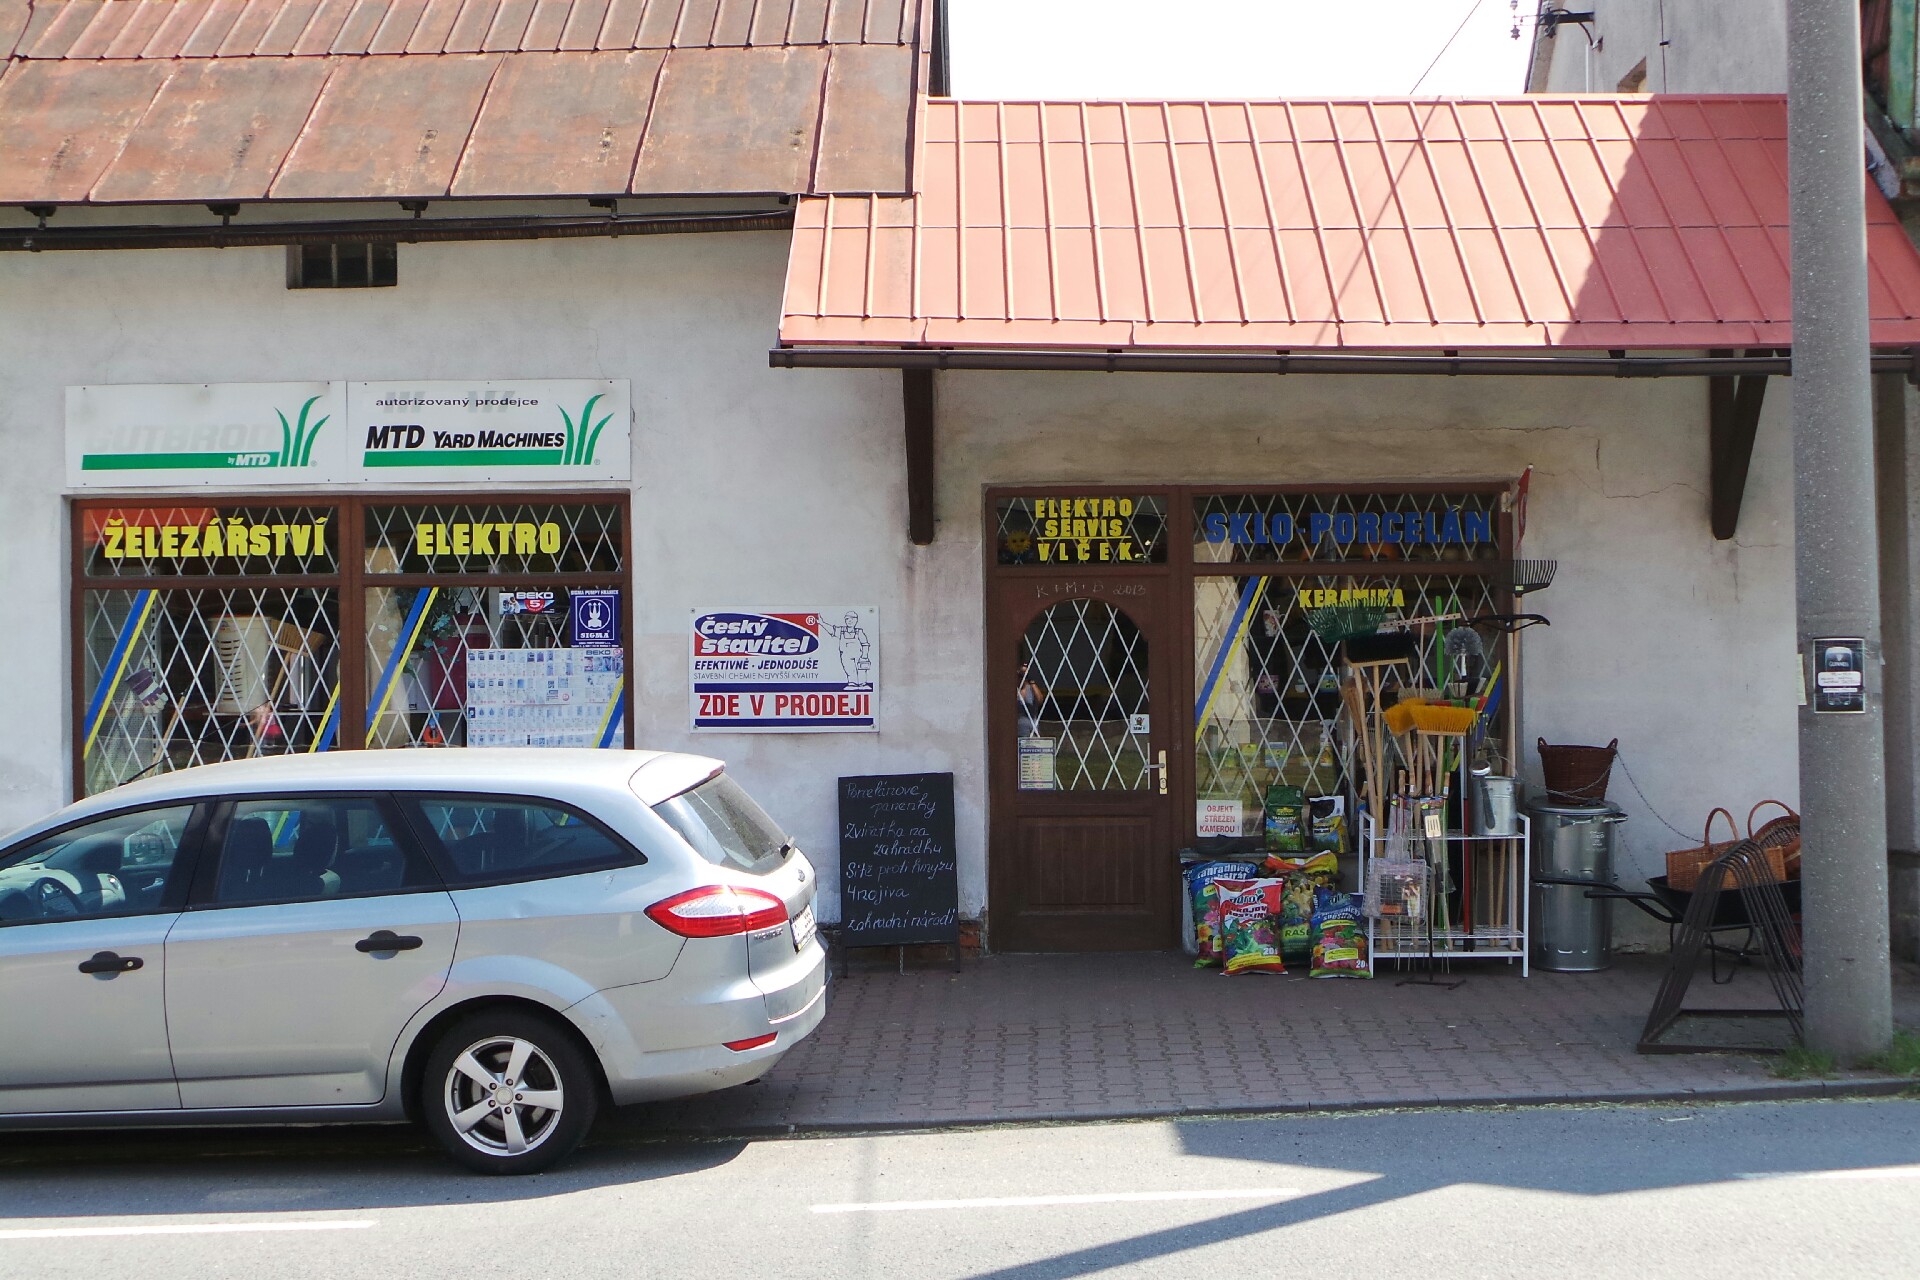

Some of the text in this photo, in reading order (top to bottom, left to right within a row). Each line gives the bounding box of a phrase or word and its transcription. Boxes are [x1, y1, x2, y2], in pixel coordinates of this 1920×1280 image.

[375, 397, 539, 408] autorizovaný prodejce
[365, 425, 425, 449] MTD
[227, 454, 271, 466] by MTD
[1035, 498, 1133, 519] ELEKTRO
[1044, 518, 1123, 537] SERVIS
[104, 517, 329, 558] ŽELEZÁŘSTVÍ
[416, 522, 561, 556] ELEKTRO
[516, 591, 554, 600] BEKO
[1112, 584, 1146, 596] 2013
[1299, 588, 1406, 608] KERAMIKA
[700, 616, 769, 636] Český
[700, 636, 811, 654] stavitel
[694, 657, 819, 670] EFEKTIVNĚ JEDNODUŠE
[693, 671, 819, 680] STAVEBNÍ CHEMIE NEJVYŠŠÍ KVALITY
[699, 693, 870, 716] ZDE V PRODEJI
[870, 792, 936, 819] panenky
[1206, 805, 1234, 813] OBJEKT
[1204, 813, 1236, 823] STŘEŽEN
[910, 826, 930, 838] na
[1199, 825, 1235, 834] KAMEROU
[873, 838, 942, 856] zahrádku
[877, 860, 909, 882] proti
[911, 858, 954, 880] hmyzu
[847, 908, 910, 932] zahradní
[1263, 947, 1275, 956] 20
[1355, 959, 1366, 969] 20
